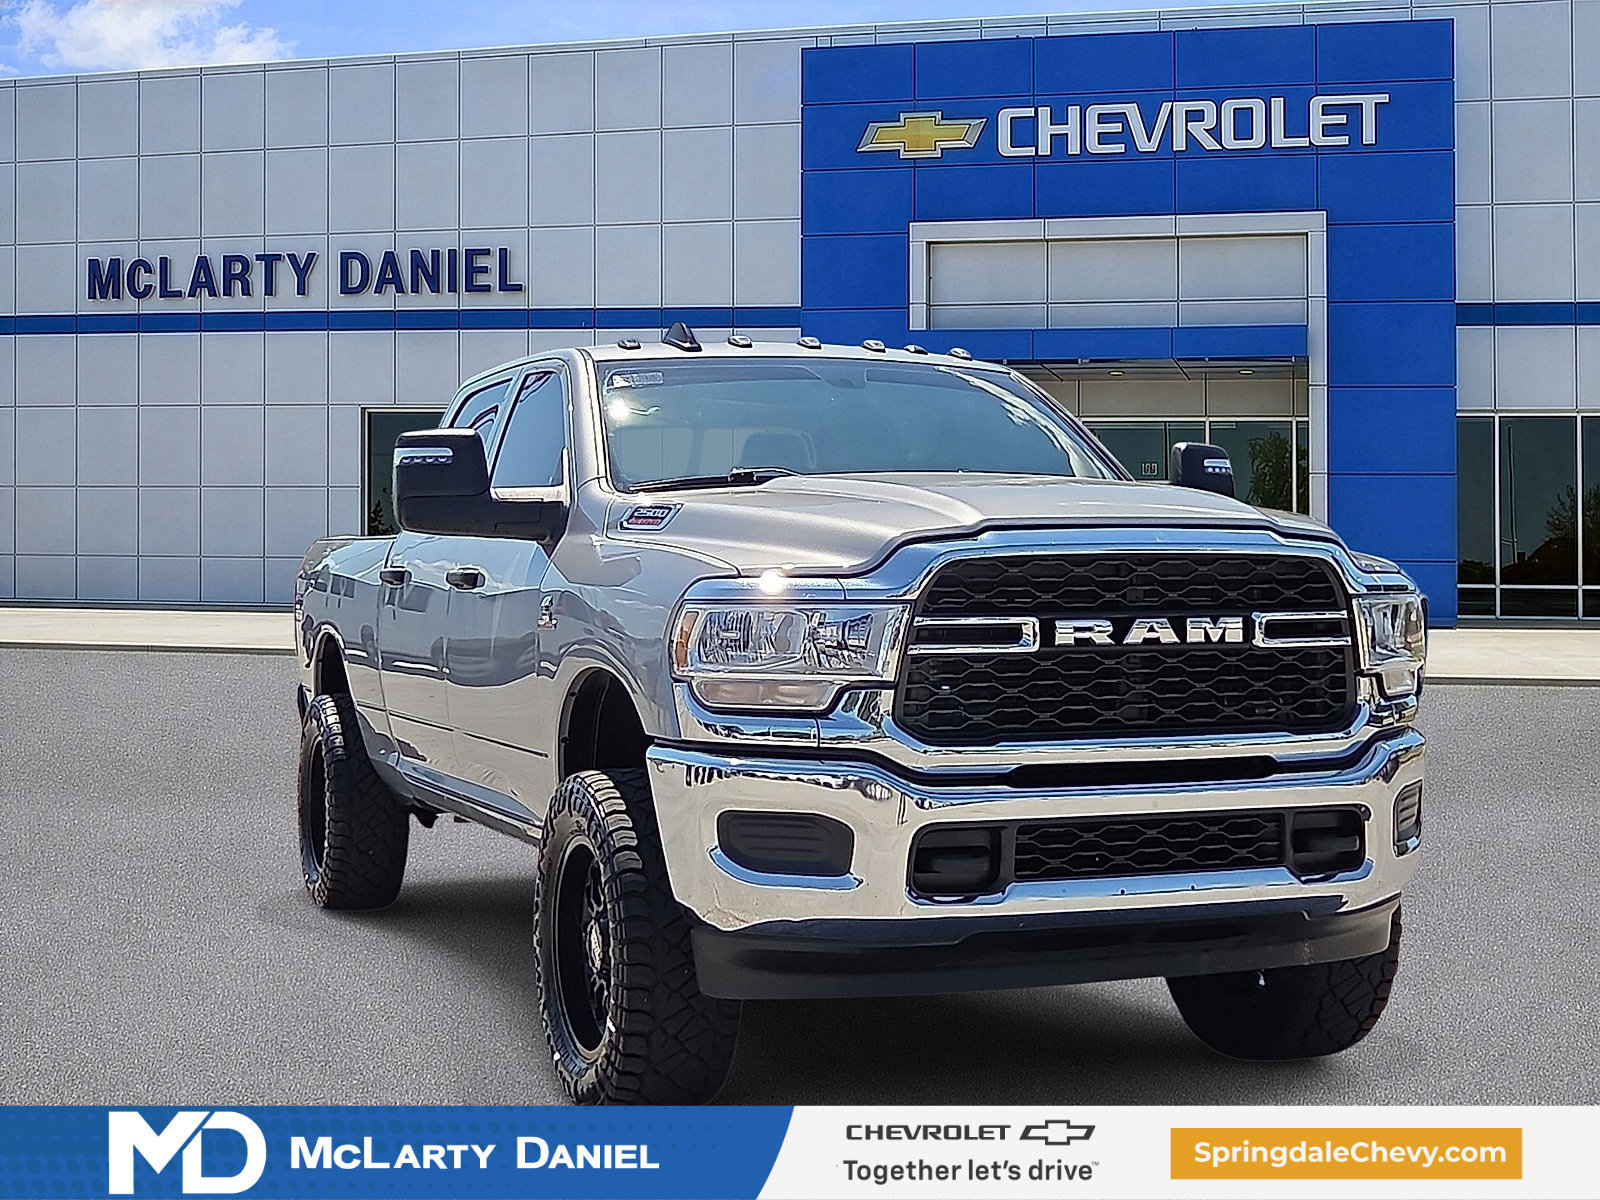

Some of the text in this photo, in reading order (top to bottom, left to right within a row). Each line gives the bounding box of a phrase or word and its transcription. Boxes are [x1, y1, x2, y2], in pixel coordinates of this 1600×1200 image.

[996, 92, 1391, 158] CHEVROLET
[86, 247, 525, 300] MCLARTY DANIEL
[1053, 615, 1245, 647] RAM
